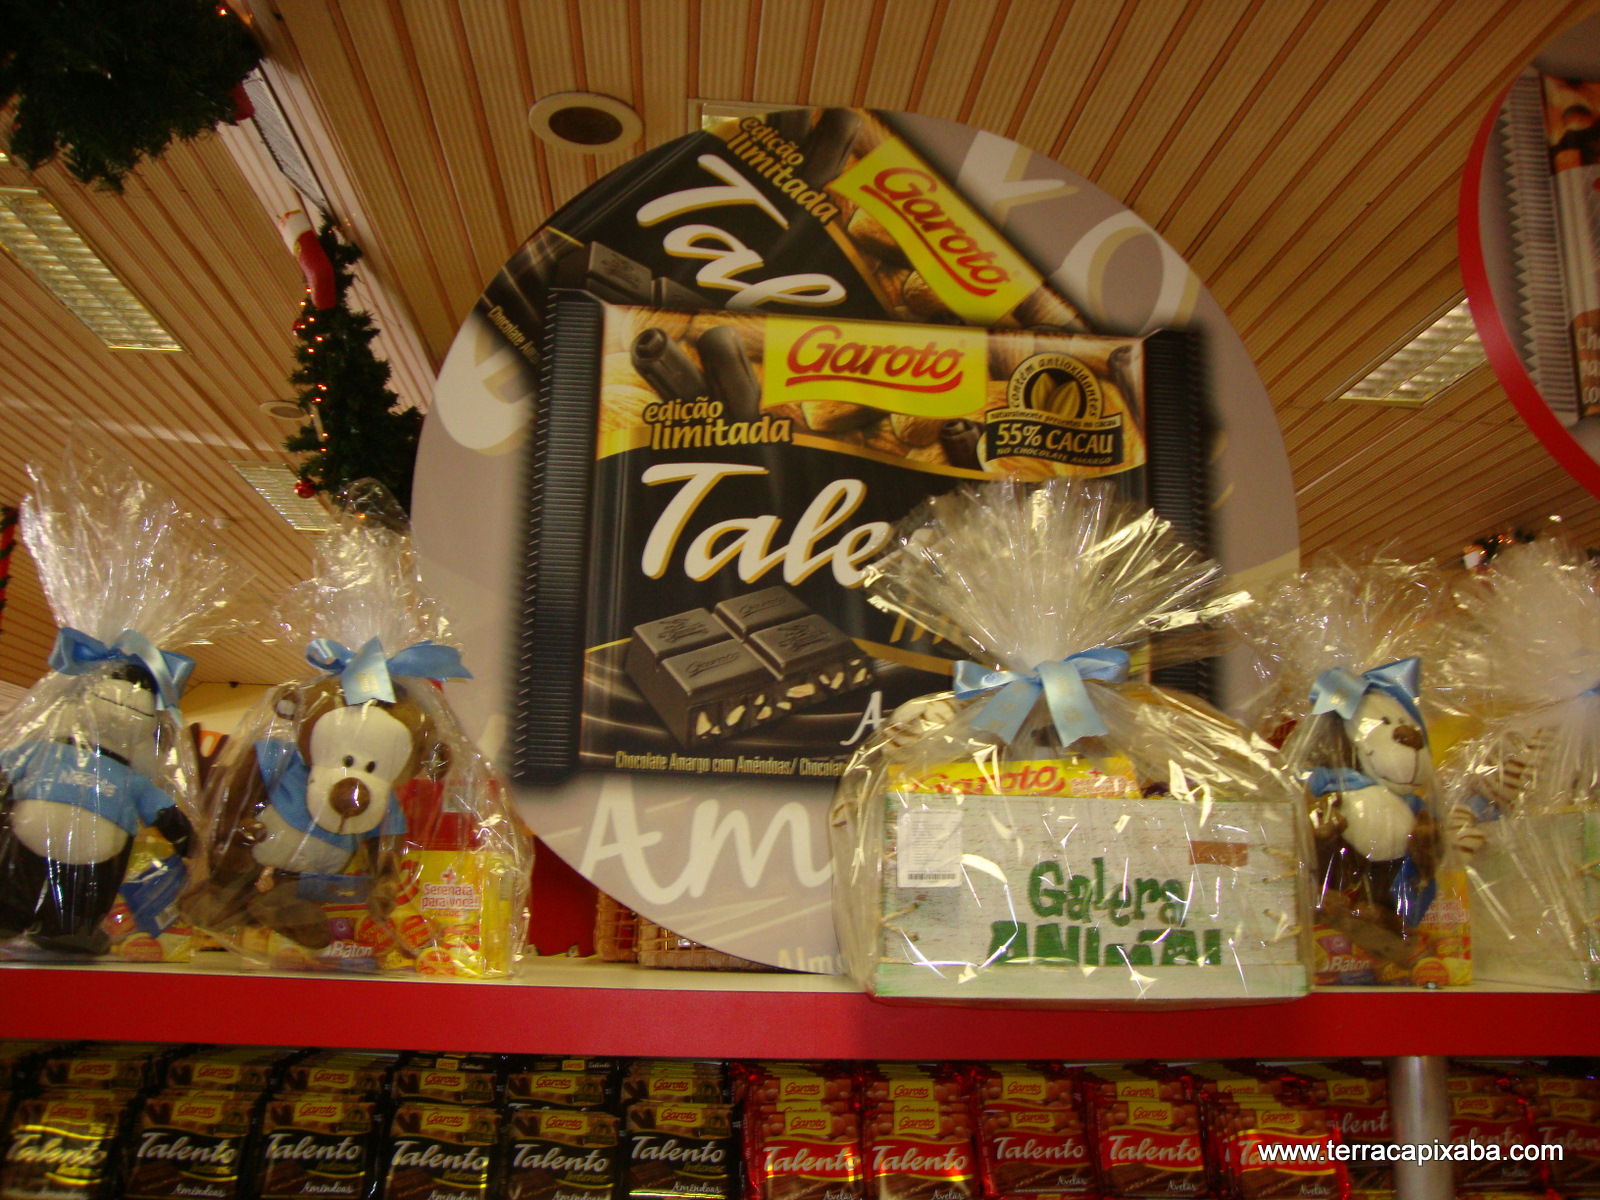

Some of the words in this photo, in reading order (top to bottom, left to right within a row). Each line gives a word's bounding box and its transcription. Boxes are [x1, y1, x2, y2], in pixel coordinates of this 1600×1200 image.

[738, 116, 804, 167] edição
[726, 133, 840, 224] limitada
[636, 153, 846, 309] Tal
[860, 166, 1012, 297] Garoto
[487, 305, 526, 347] Chocolate
[785, 323, 965, 393] Garoto
[643, 396, 724, 421] edição
[650, 414, 794, 451] limitada
[995, 422, 1043, 447] 55%
[1044, 429, 1115, 455] CACAU
[615, 750, 668, 770] Chocolate
[669, 752, 712, 774] Amargo
[712, 758, 736, 774] com
[799, 757, 851, 777] Chocolat
[577, 770, 836, 905] Am
[423, 883, 474, 897] Serenata
[1028, 857, 1187, 927] Galera
[422, 897, 446, 910] para
[331, 940, 373, 959] Baton
[1330, 956, 1371, 973] Baton
[424, 1072, 461, 1087] Garoto
[535, 1075, 572, 1090] Garoto
[653, 1078, 689, 1092] Garoto
[784, 1081, 821, 1097] Garoto
[893, 1084, 930, 1099] Garoto
[1007, 1080, 1042, 1095] Garoto
[177, 1102, 217, 1119] Garoto
[299, 1102, 337, 1118] Garoto
[425, 1111, 465, 1128] Garoto
[660, 1108, 698, 1123] Garoto
[1014, 1111, 1051, 1124] Garoto
[1132, 1106, 1168, 1121] Garoto
[1260, 1111, 1296, 1124] Garoto
[545, 1115, 583, 1130] Garoto
[789, 1116, 827, 1131] Garoto
[898, 1116, 936, 1131] Garoto
[6, 1133, 109, 1166] Talento
[137, 1131, 238, 1164] Talento
[264, 1132, 364, 1162] Talento
[391, 1140, 490, 1171] Talento
[512, 1143, 611, 1173] Talento
[630, 1135, 727, 1163] Talento
[762, 1145, 862, 1172] Talento
[871, 1145, 969, 1172] Talento
[992, 1136, 1087, 1160] Talento
[1107, 1135, 1202, 1162] Talento
